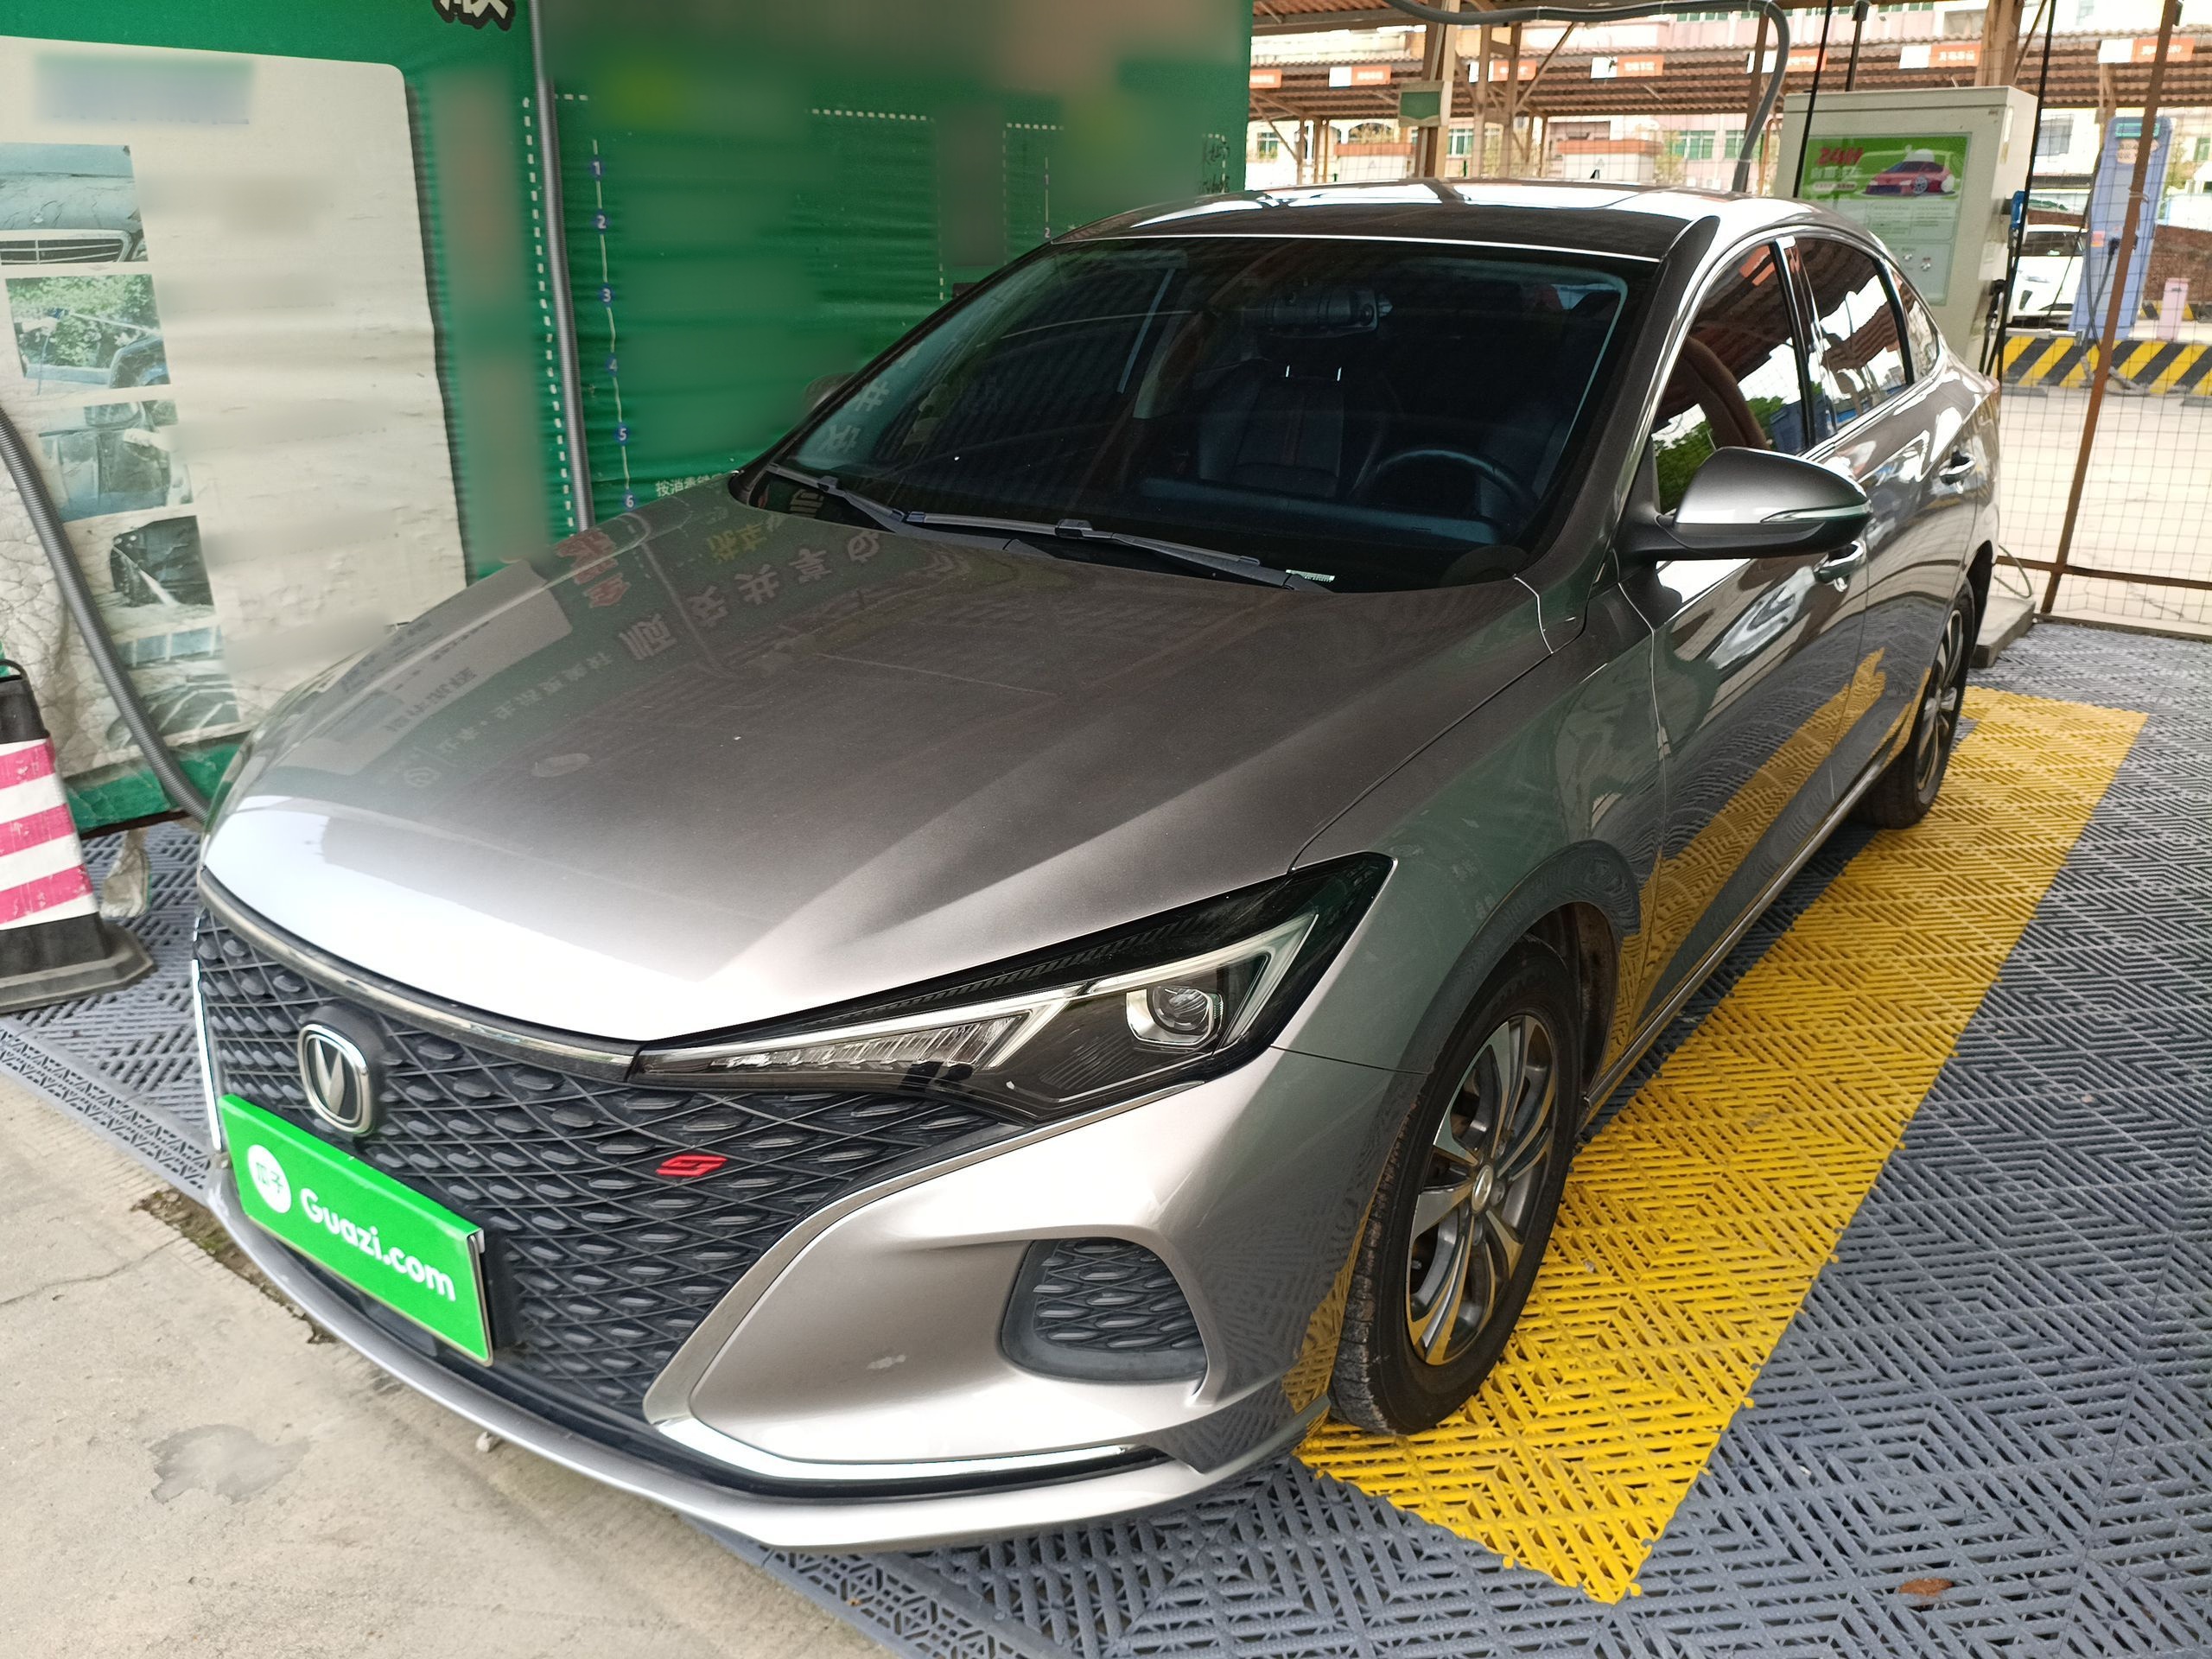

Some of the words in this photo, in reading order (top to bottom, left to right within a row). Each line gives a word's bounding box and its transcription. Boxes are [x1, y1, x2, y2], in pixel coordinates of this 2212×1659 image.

[593, 162, 601, 176] 1
[596, 215, 607, 230] 2
[602, 288, 612, 302] 3
[619, 428, 627, 442] 5
[626, 494, 634, 508] 6
[300, 1188, 457, 1303] Guazi.com
